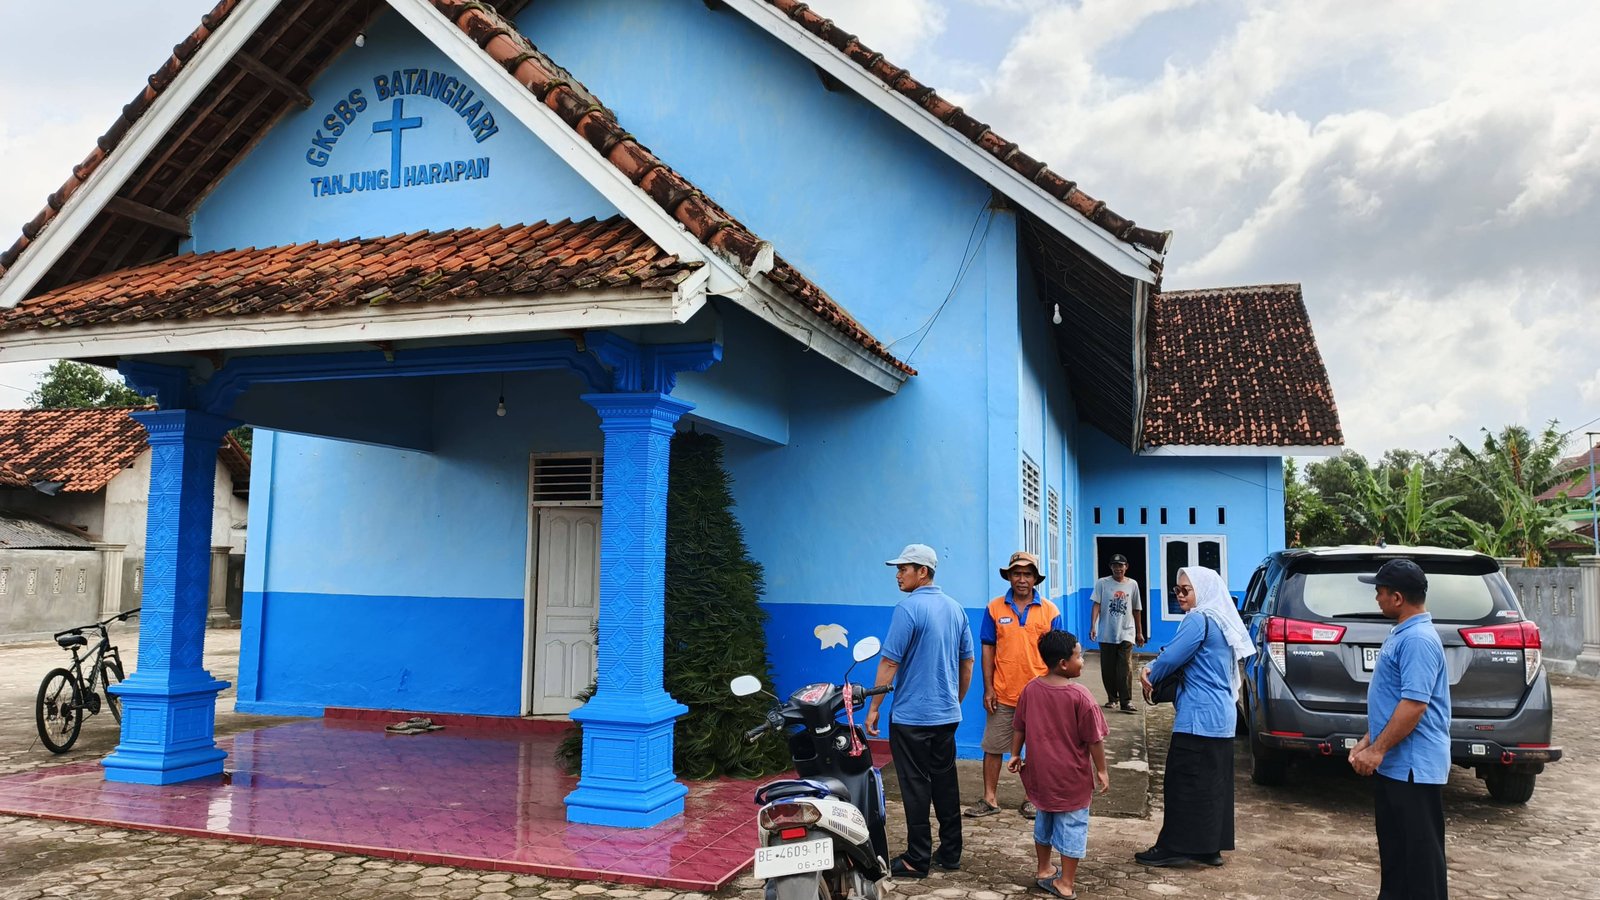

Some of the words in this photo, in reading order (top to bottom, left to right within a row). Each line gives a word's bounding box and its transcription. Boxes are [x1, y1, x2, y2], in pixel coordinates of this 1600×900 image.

[306, 89, 367, 167] GKSBS
[373, 69, 498, 143] BATANGHARI
[311, 170, 389, 197] TANJUNG
[404, 157, 490, 187] HARAPAN
[758, 849, 772, 862] BE
[780, 845, 808, 858] 4609
[815, 842, 829, 854] PF
